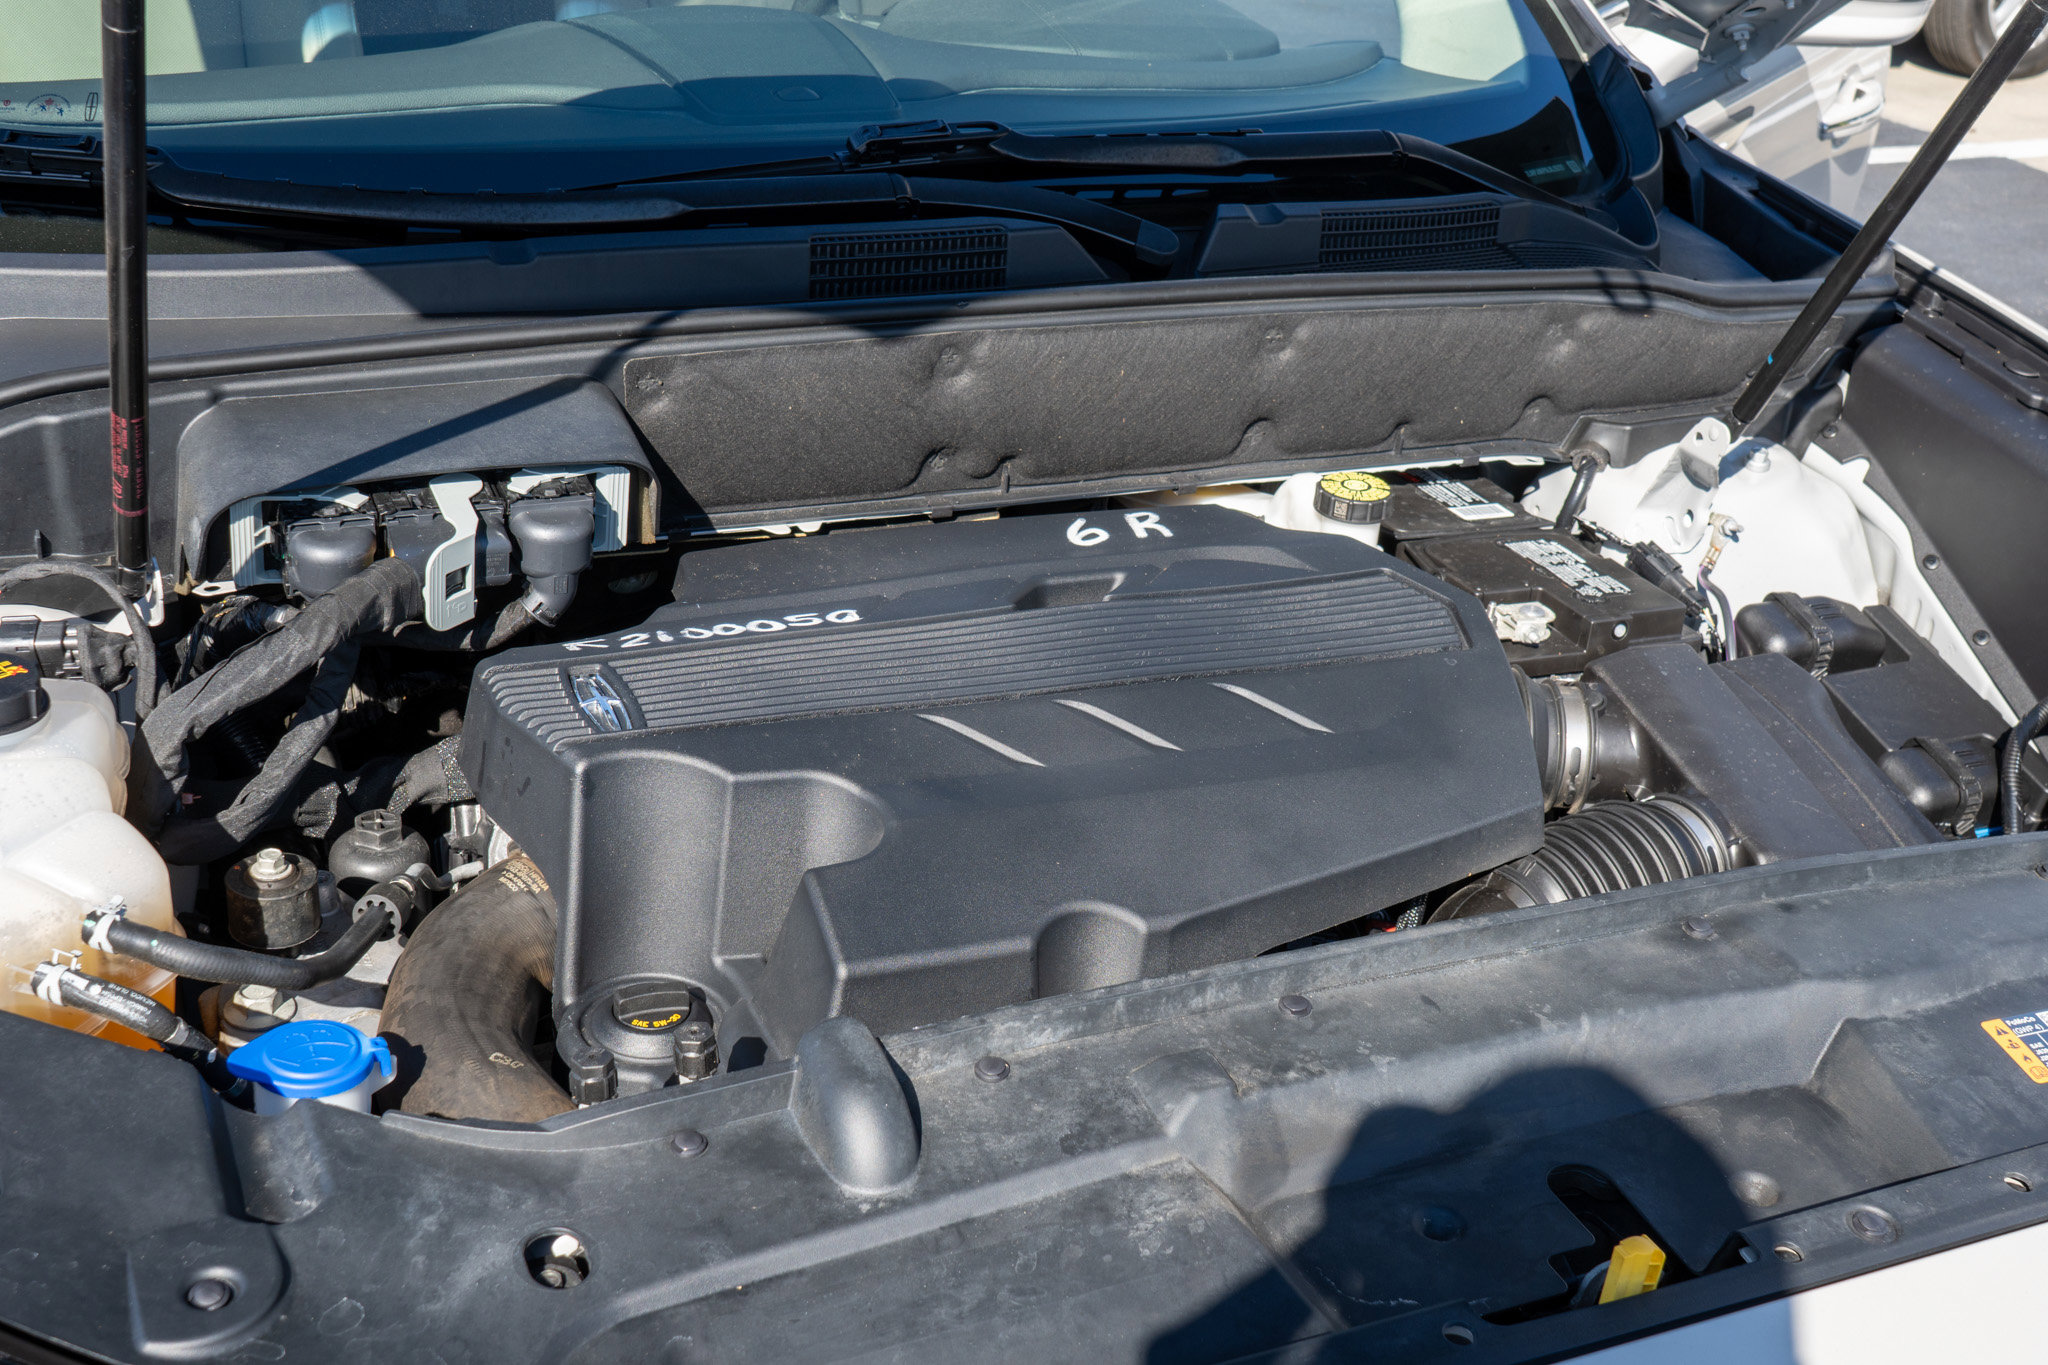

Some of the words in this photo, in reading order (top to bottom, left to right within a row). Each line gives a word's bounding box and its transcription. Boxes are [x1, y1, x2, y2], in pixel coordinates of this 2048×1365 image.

[1066, 517, 1110, 547] 6
[1123, 511, 1174, 538] R
[2005, 1016, 2036, 1026] FoMoCo
